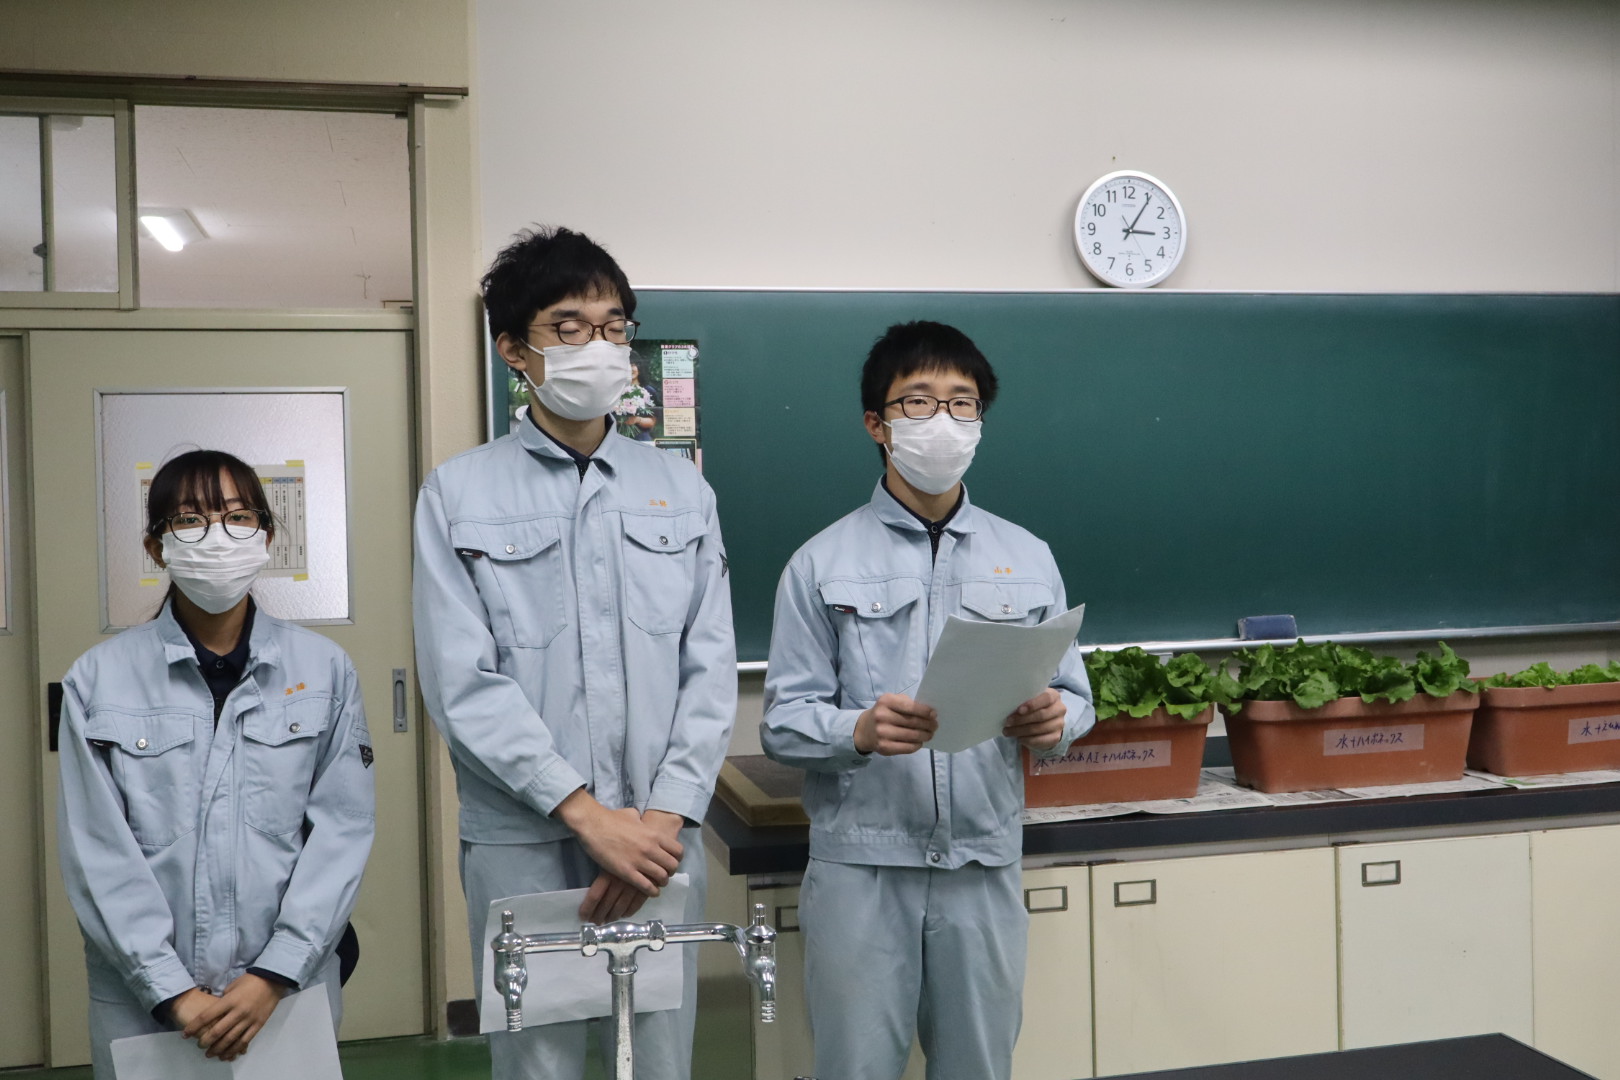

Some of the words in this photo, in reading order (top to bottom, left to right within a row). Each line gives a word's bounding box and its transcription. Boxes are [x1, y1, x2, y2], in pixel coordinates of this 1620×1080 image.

[1106, 189, 1117, 203] 11
[1122, 185, 1136, 200] 12
[1092, 203, 1106, 217] 10
[1156, 206, 1165, 220] 2
[1087, 222, 1096, 236] 9
[1162, 226, 1171, 240] 3
[1093, 241, 1102, 255] 8
[1156, 245, 1165, 259] 4
[1107, 256, 1116, 270] 7
[1125, 262, 1134, 276] 6
[1144, 259, 1153, 273] 5
